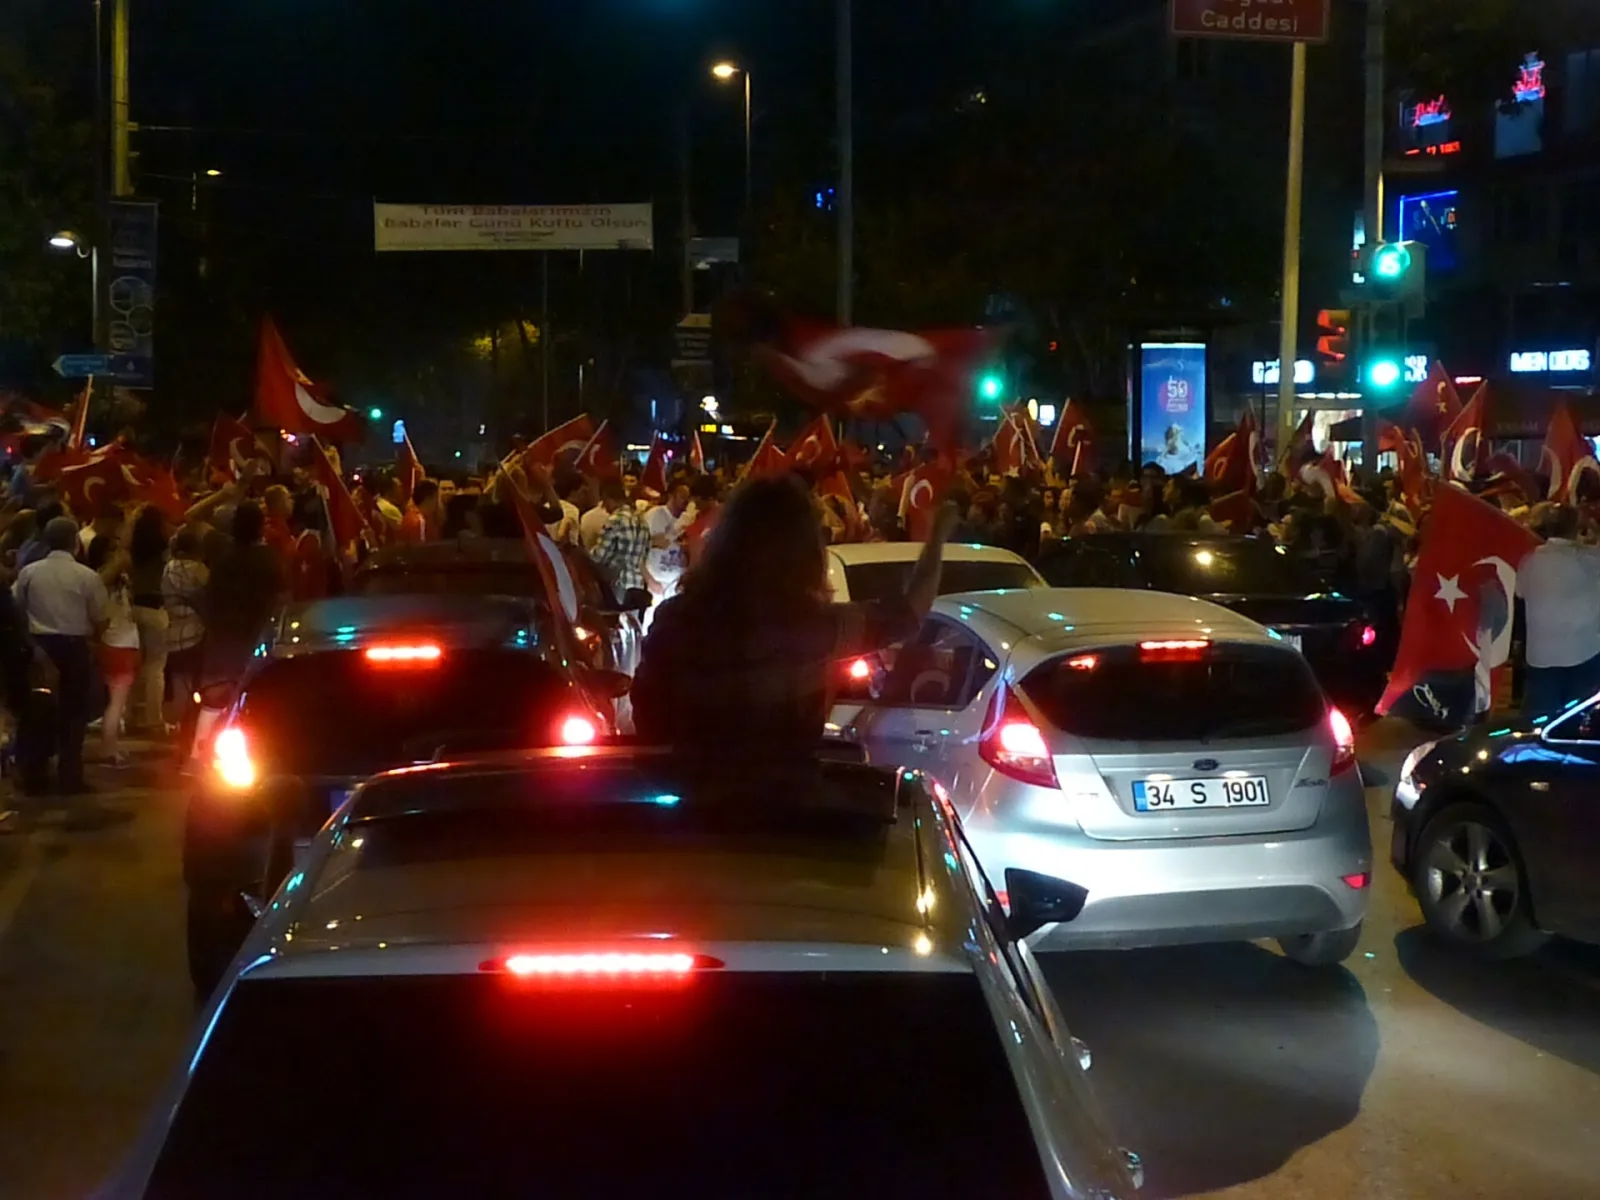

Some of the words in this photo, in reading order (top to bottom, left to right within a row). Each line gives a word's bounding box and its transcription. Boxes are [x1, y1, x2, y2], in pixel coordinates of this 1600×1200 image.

[1199, 8, 1299, 33] Caddesi
[384, 217, 460, 229] Babalar
[529, 217, 584, 230] Kutlu
[590, 217, 649, 229] Olsun
[1147, 783, 1176, 807] 34
[1190, 782, 1207, 805] S
[1221, 779, 1267, 804] 1901
